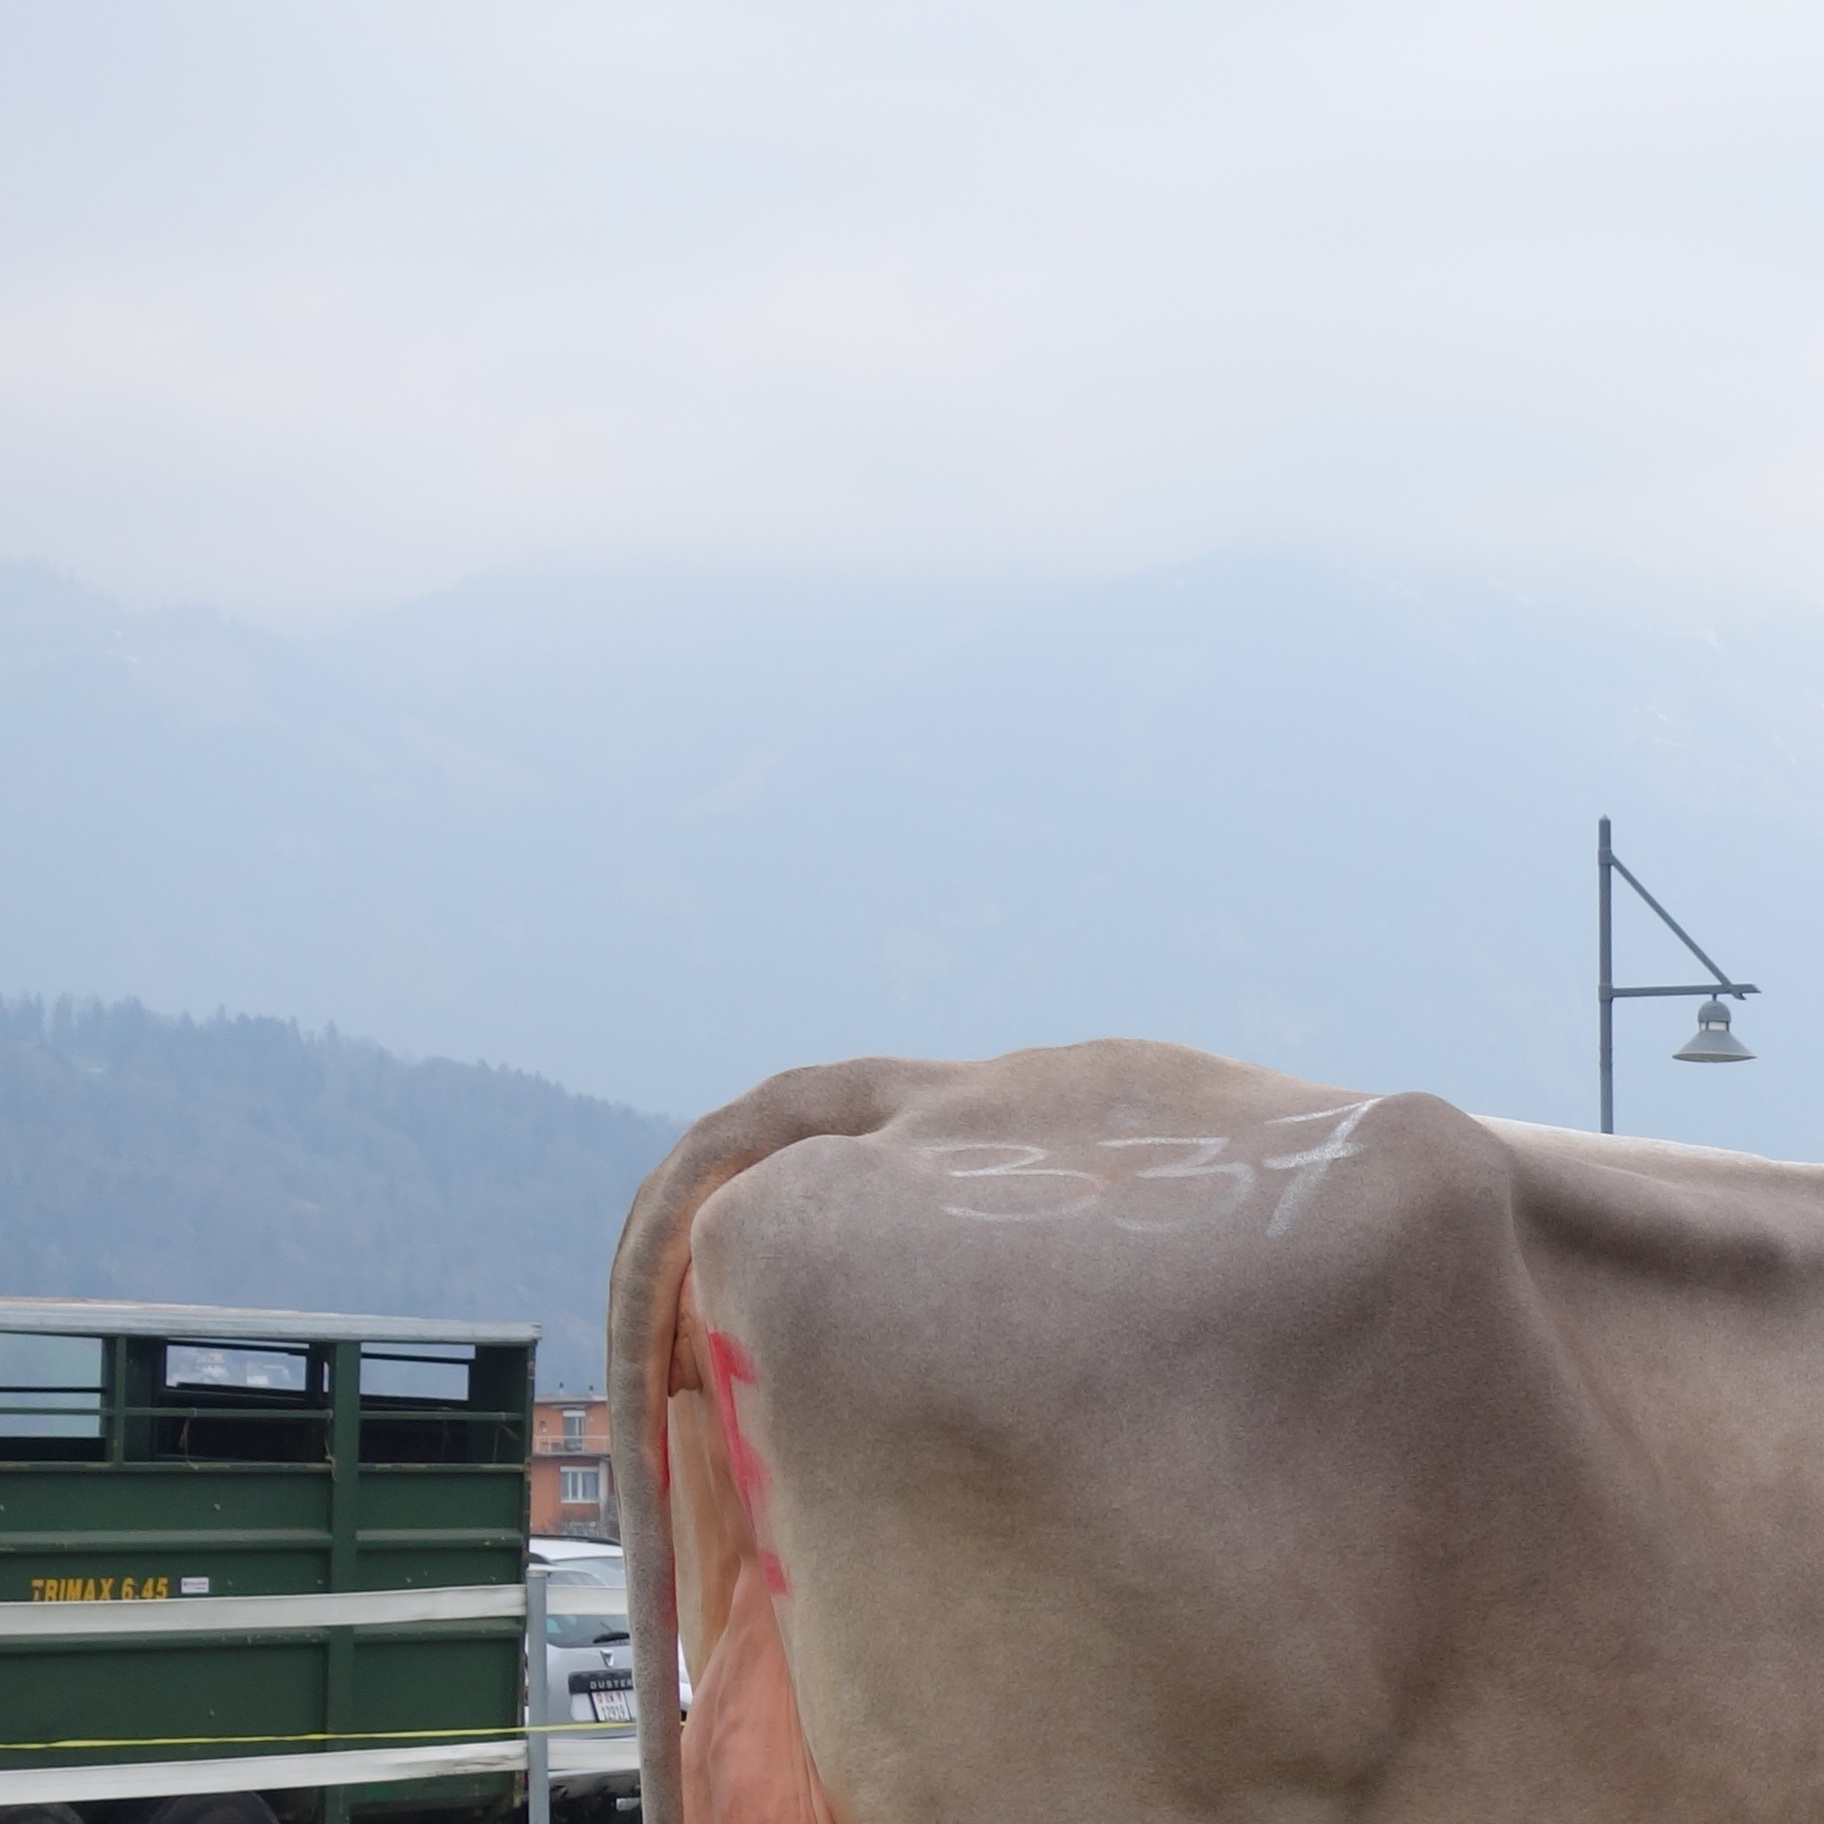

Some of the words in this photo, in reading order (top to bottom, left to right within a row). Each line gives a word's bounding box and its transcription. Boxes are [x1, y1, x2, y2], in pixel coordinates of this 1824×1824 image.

[31, 1578, 114, 1601] TRIMAX
[121, 1576, 168, 1600] 6.45
[590, 1679, 633, 1690] DUSTER
